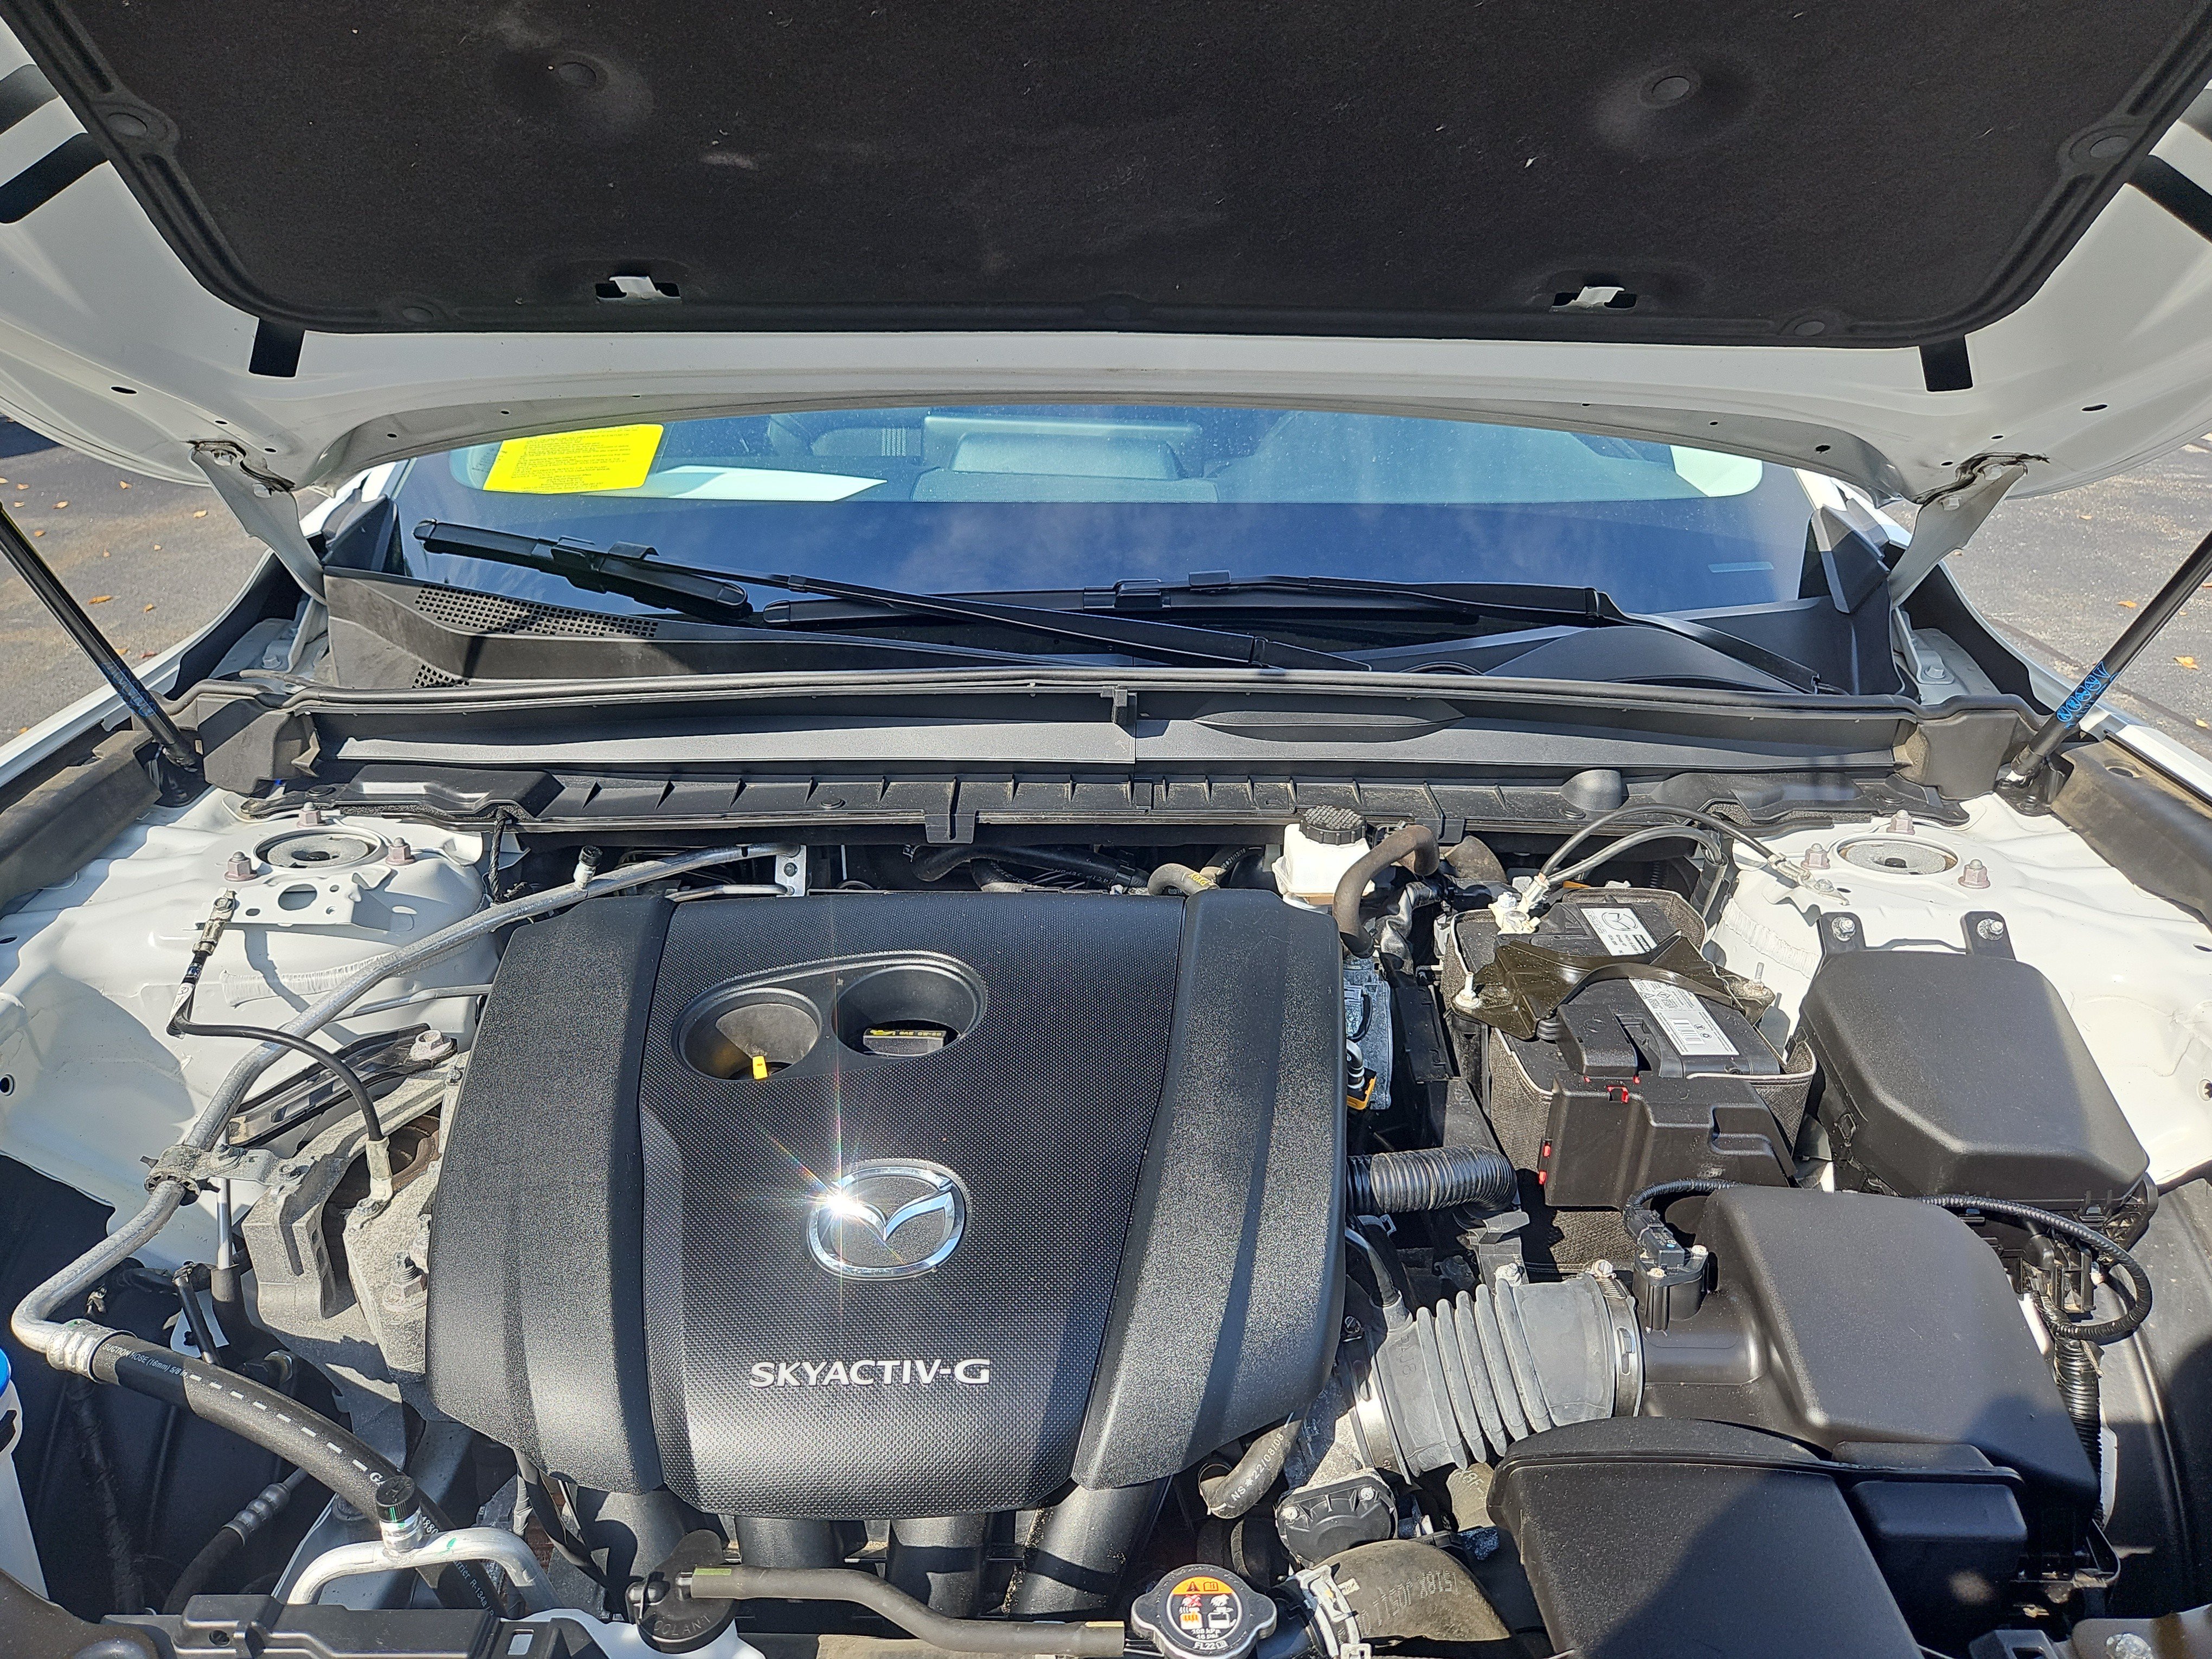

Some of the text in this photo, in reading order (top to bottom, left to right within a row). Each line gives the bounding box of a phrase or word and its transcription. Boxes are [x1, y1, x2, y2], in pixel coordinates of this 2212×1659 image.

[129, 1351, 149, 1364] HOSE
[146, 1357, 171, 1372] (16mm)
[169, 1366, 182, 1375] 5/8
[748, 1358, 991, 1387] SKYACTIV-G
[1230, 1486, 1246, 1501] NS
[470, 1578, 487, 1607] R-134a
[1192, 1642, 1216, 1650] FL22
